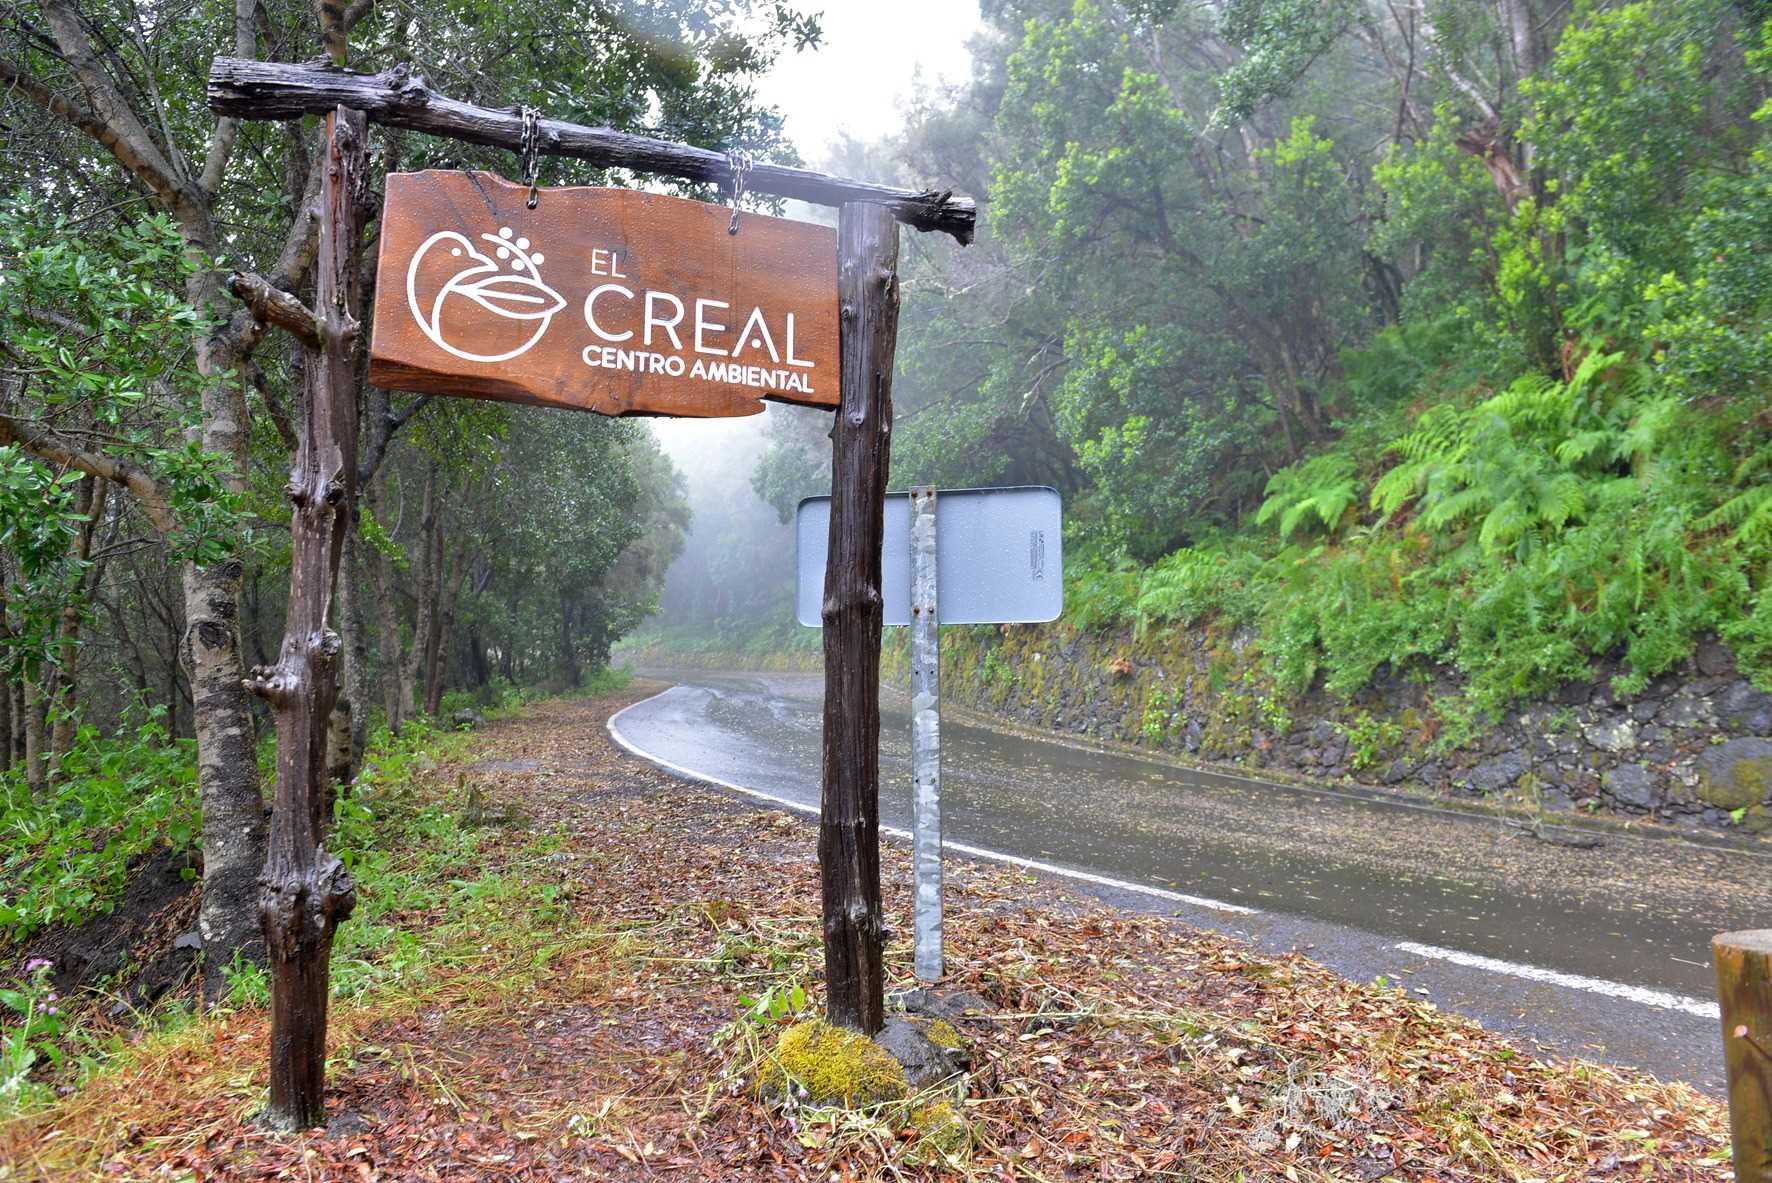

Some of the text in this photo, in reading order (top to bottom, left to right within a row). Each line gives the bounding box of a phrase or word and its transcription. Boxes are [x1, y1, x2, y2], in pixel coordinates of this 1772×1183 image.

[591, 248, 627, 278] EL
[584, 283, 815, 368] CREAL
[582, 345, 815, 393] CENTRO AMBIENTAL
